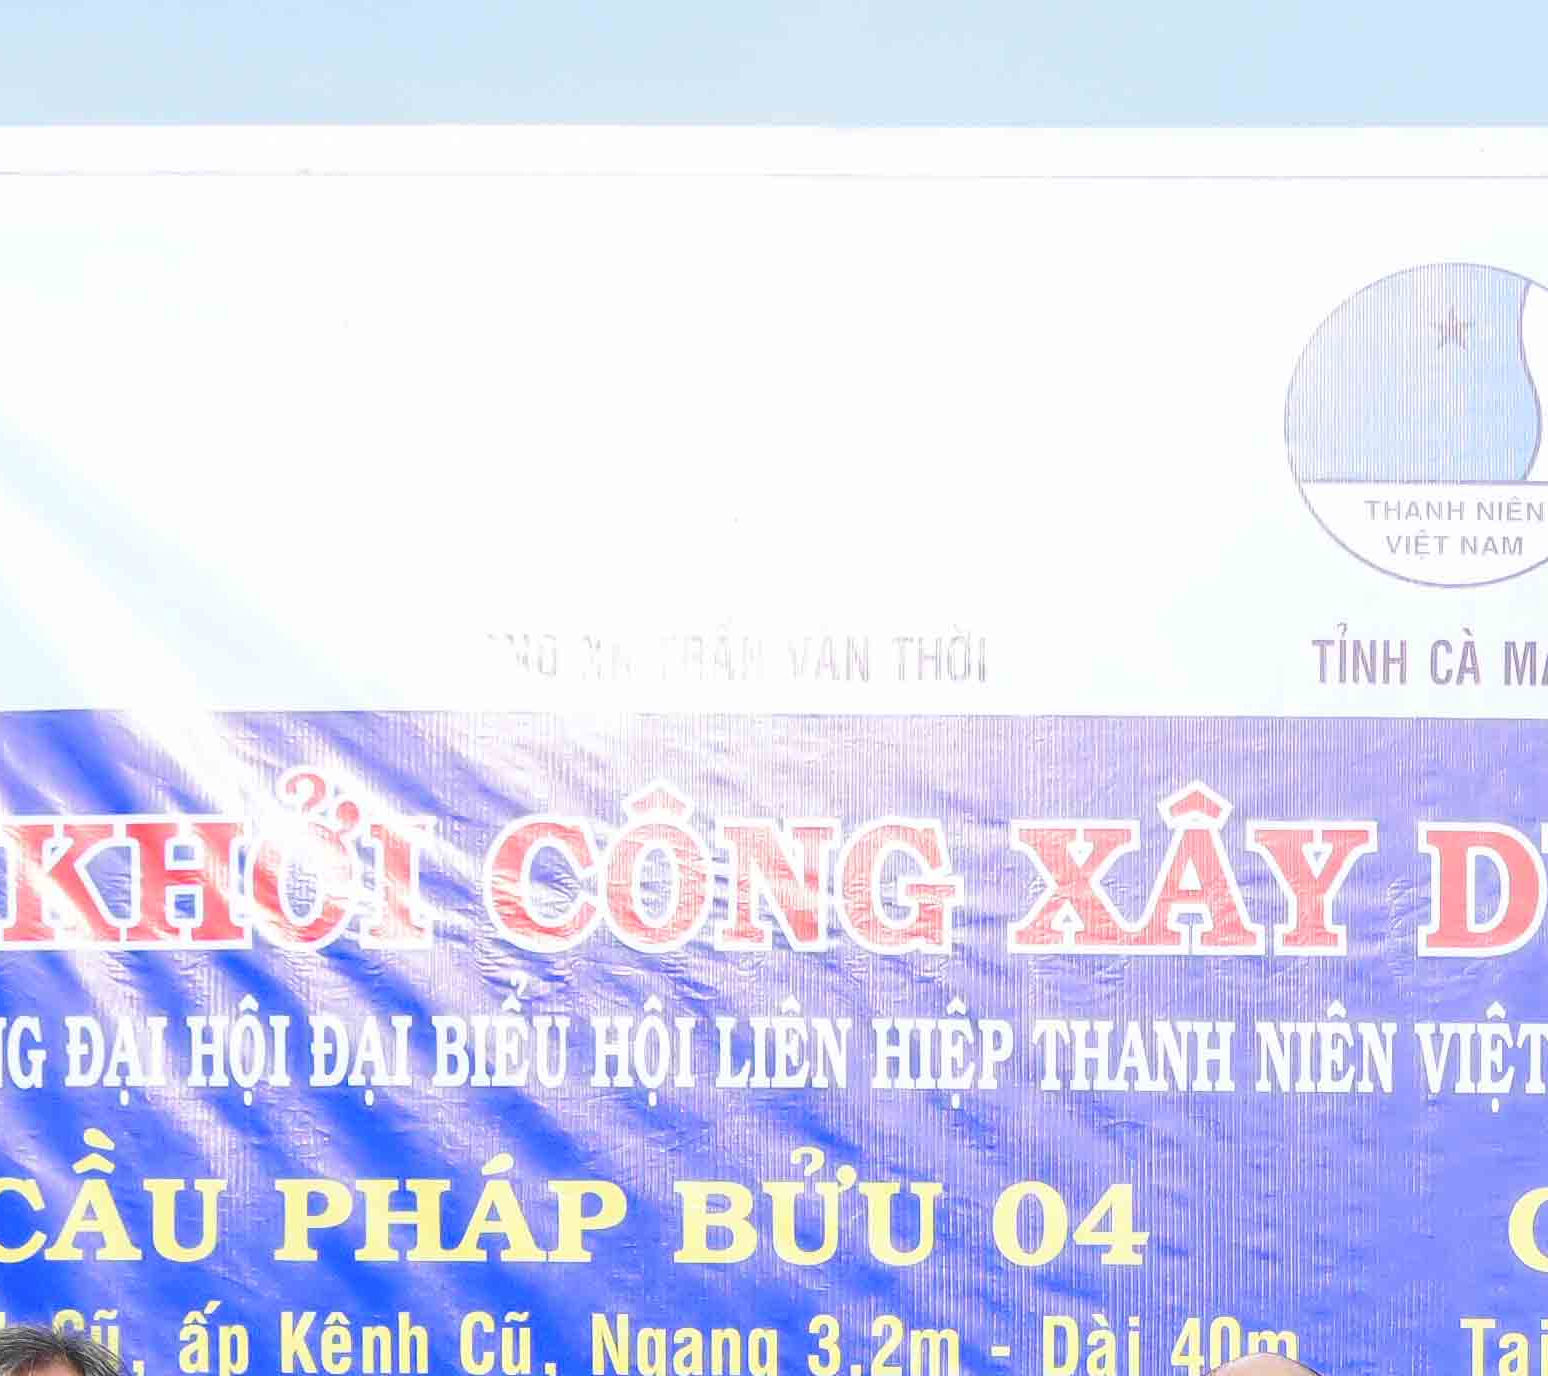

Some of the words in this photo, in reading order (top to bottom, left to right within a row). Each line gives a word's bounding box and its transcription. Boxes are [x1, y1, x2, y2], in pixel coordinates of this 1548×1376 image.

[1363, 499, 1465, 521] THANH
[1476, 496, 1545, 521] NIÊN
[1385, 529, 1450, 559] VIỆT
[1460, 534, 1524, 556] NAM
[890, 621, 990, 685] THỜI
[1311, 624, 1407, 686] TỈNH
[1429, 622, 1483, 686] CÀ
[484, 779, 965, 955] CÔNG
[1008, 781, 1377, 956] XÂY
[66, 1014, 168, 1106] ĐẠI
[189, 995, 291, 1106] HỘI
[309, 1014, 413, 1106] ĐẠI
[433, 973, 570, 1089] BIỂU
[591, 995, 696, 1107] HỘI
[715, 998, 850, 1089] LIÊN
[871, 998, 1013, 1109] HIỆP
[1031, 1019, 1235, 1093] THANH
[1256, 1000, 1397, 1093] NIÊN
[275, 1152, 629, 1264] PHÁP
[673, 1146, 943, 1267] BỬU
[993, 1181, 1150, 1267] 04
[281, 1310, 430, 1376] Kênh
